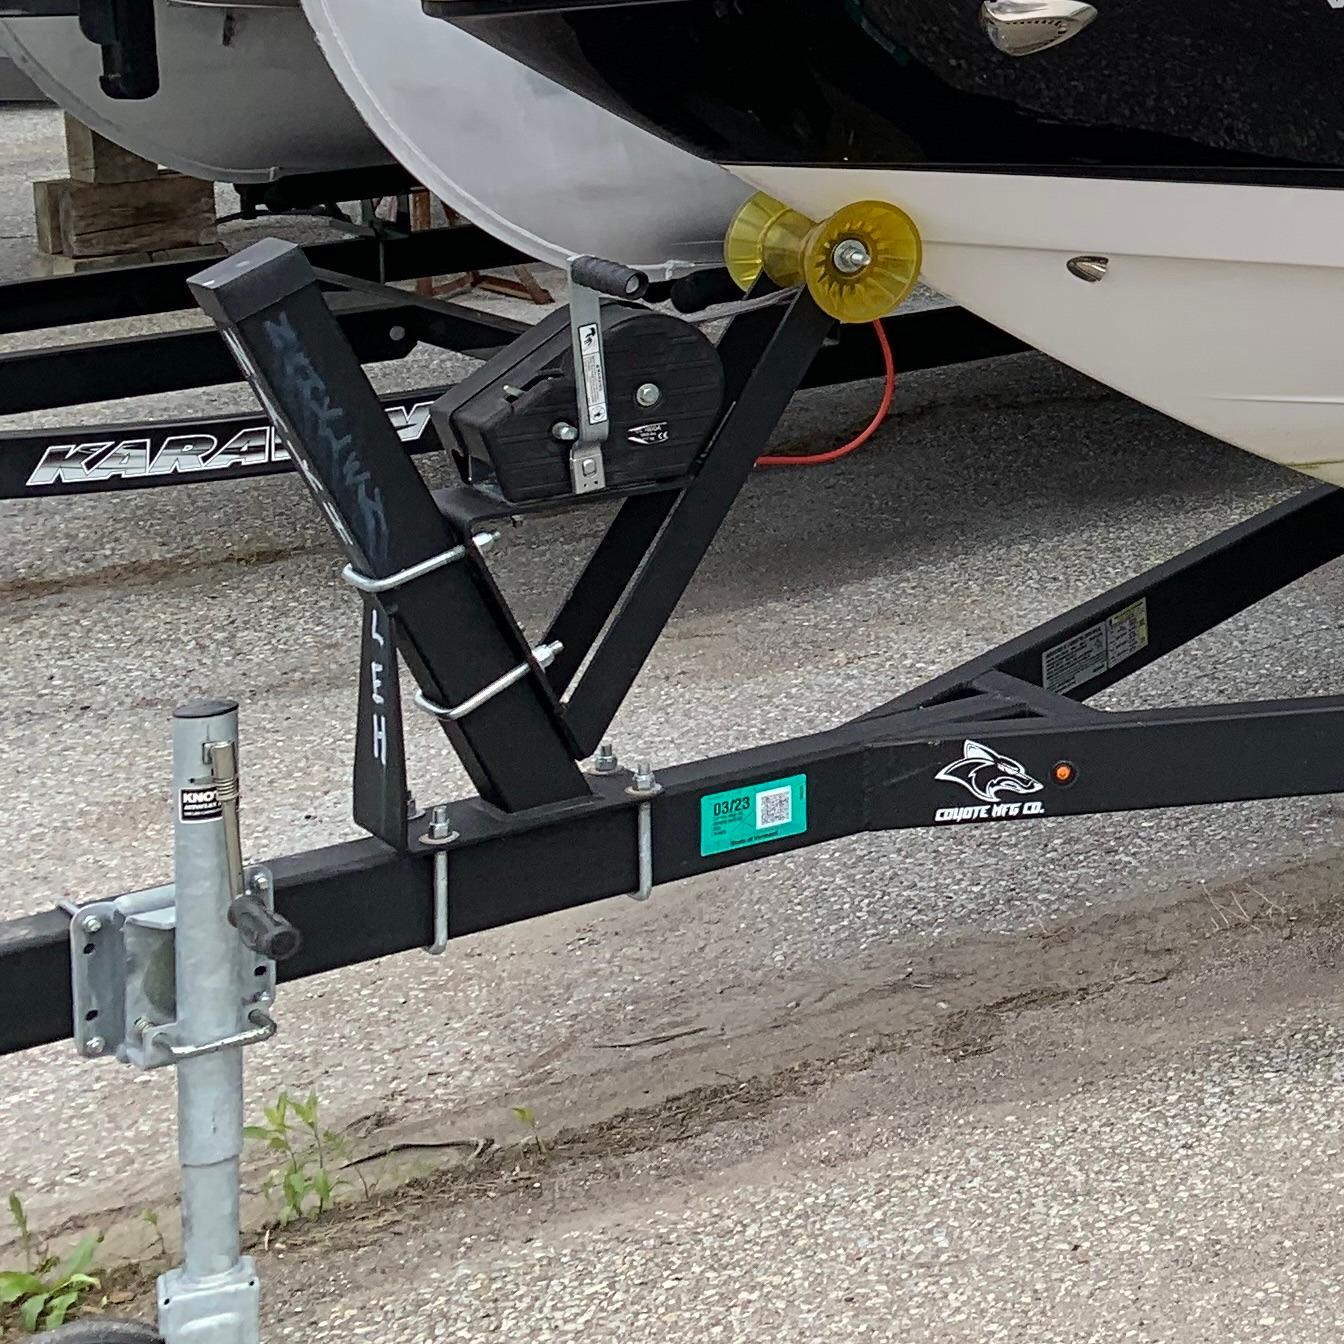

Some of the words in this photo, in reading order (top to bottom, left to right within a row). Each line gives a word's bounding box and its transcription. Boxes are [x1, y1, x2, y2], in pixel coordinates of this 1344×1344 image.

[713, 796, 751, 816] 03/23
[934, 805, 991, 822] COYOTE
[991, 803, 1022, 818] MFG
[1022, 801, 1045, 815] CO.
